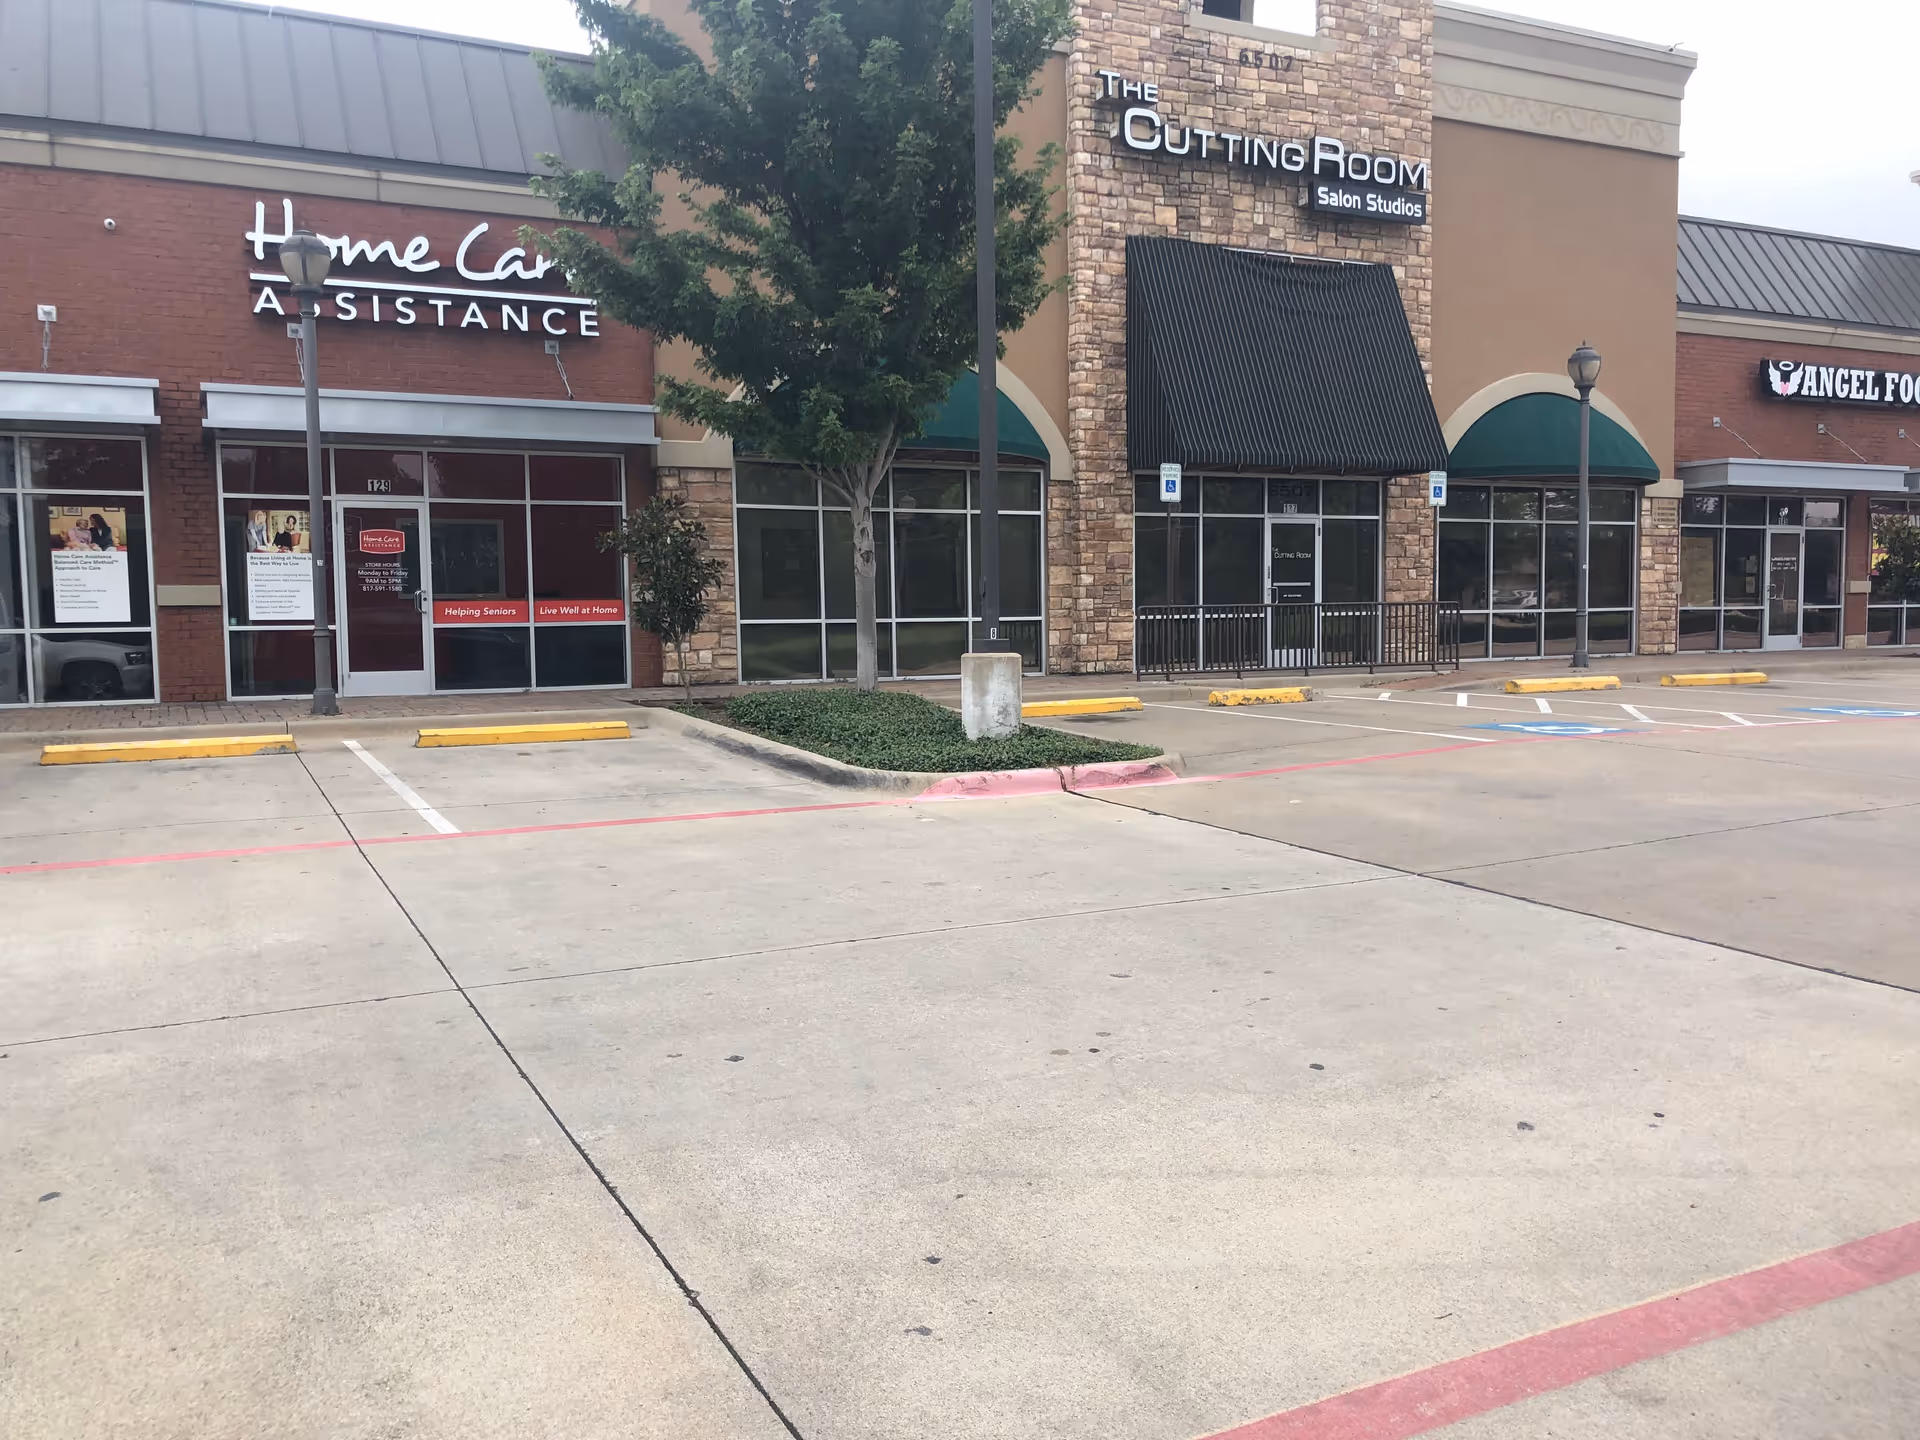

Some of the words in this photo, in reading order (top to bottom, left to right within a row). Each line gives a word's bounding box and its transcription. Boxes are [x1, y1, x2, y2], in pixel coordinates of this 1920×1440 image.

[1239, 48, 1294, 72] 6507
[1099, 69, 1159, 102] THE
[1123, 108, 1305, 171] CUTTING
[1314, 136, 1428, 190] ROOM
[1317, 187, 1361, 210] Salon
[1367, 194, 1423, 218] Studios
[456, 222, 578, 283] Car
[1801, 365, 1880, 401] ANGEL
[368, 480, 391, 492] 129
[363, 534, 383, 542] Home
[383, 535, 400, 543] Care
[358, 569, 381, 577] Monday
[390, 569, 408, 577] Friday
[444, 607, 481, 618] Helping
[483, 606, 517, 616] Seniors
[540, 606, 558, 615] Live
[560, 605, 579, 615] Well
[581, 606, 590, 615] at
[592, 605, 618, 615] Home
